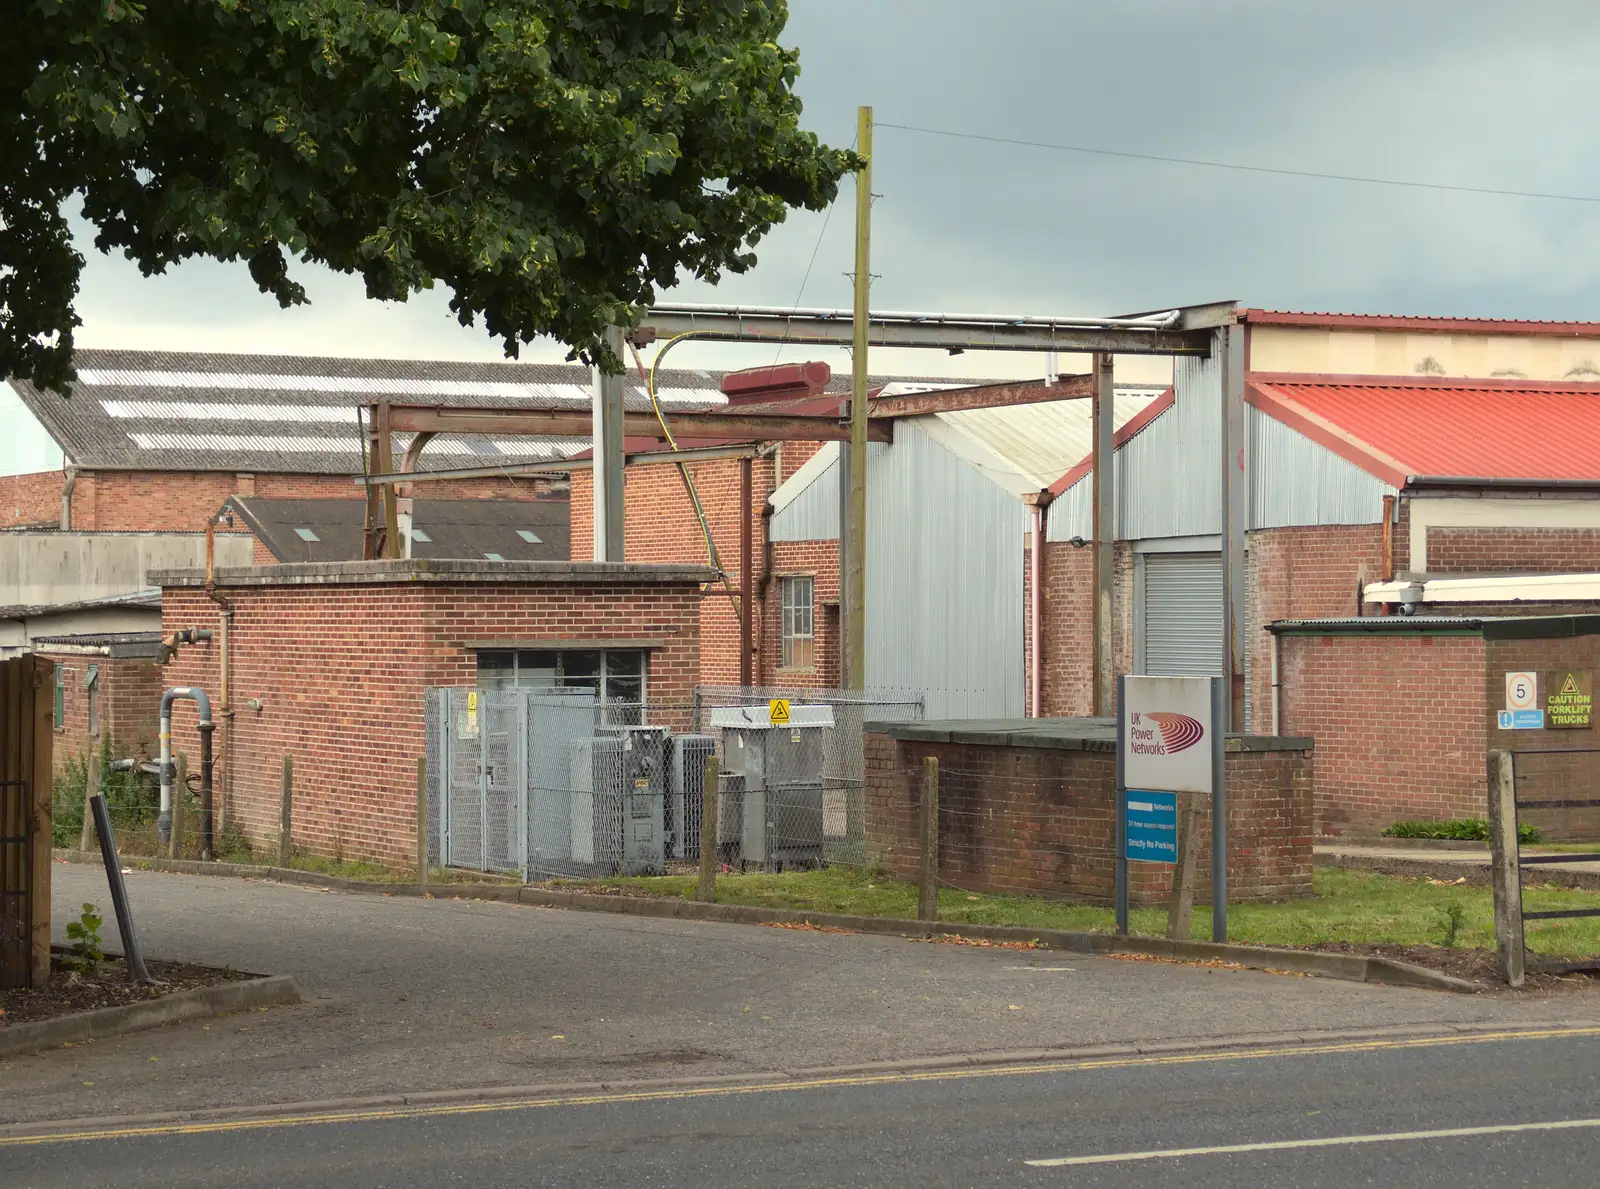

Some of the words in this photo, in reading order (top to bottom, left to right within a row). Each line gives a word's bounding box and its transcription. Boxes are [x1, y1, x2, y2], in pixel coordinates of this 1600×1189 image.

[1516, 684, 1526, 699] 5
[1548, 695, 1590, 704] CAUTION
[1547, 705, 1592, 714] FORKLIFT
[1131, 712, 1141, 725] UK
[1551, 715, 1589, 724] TRUCKS
[1131, 727, 1154, 741] Power
[1131, 741, 1166, 756] Networks
[1153, 803, 1174, 811] Networks
[1128, 838, 1146, 850] Strictly
[1146, 840, 1154, 849] No
[1155, 841, 1175, 852] Parking
